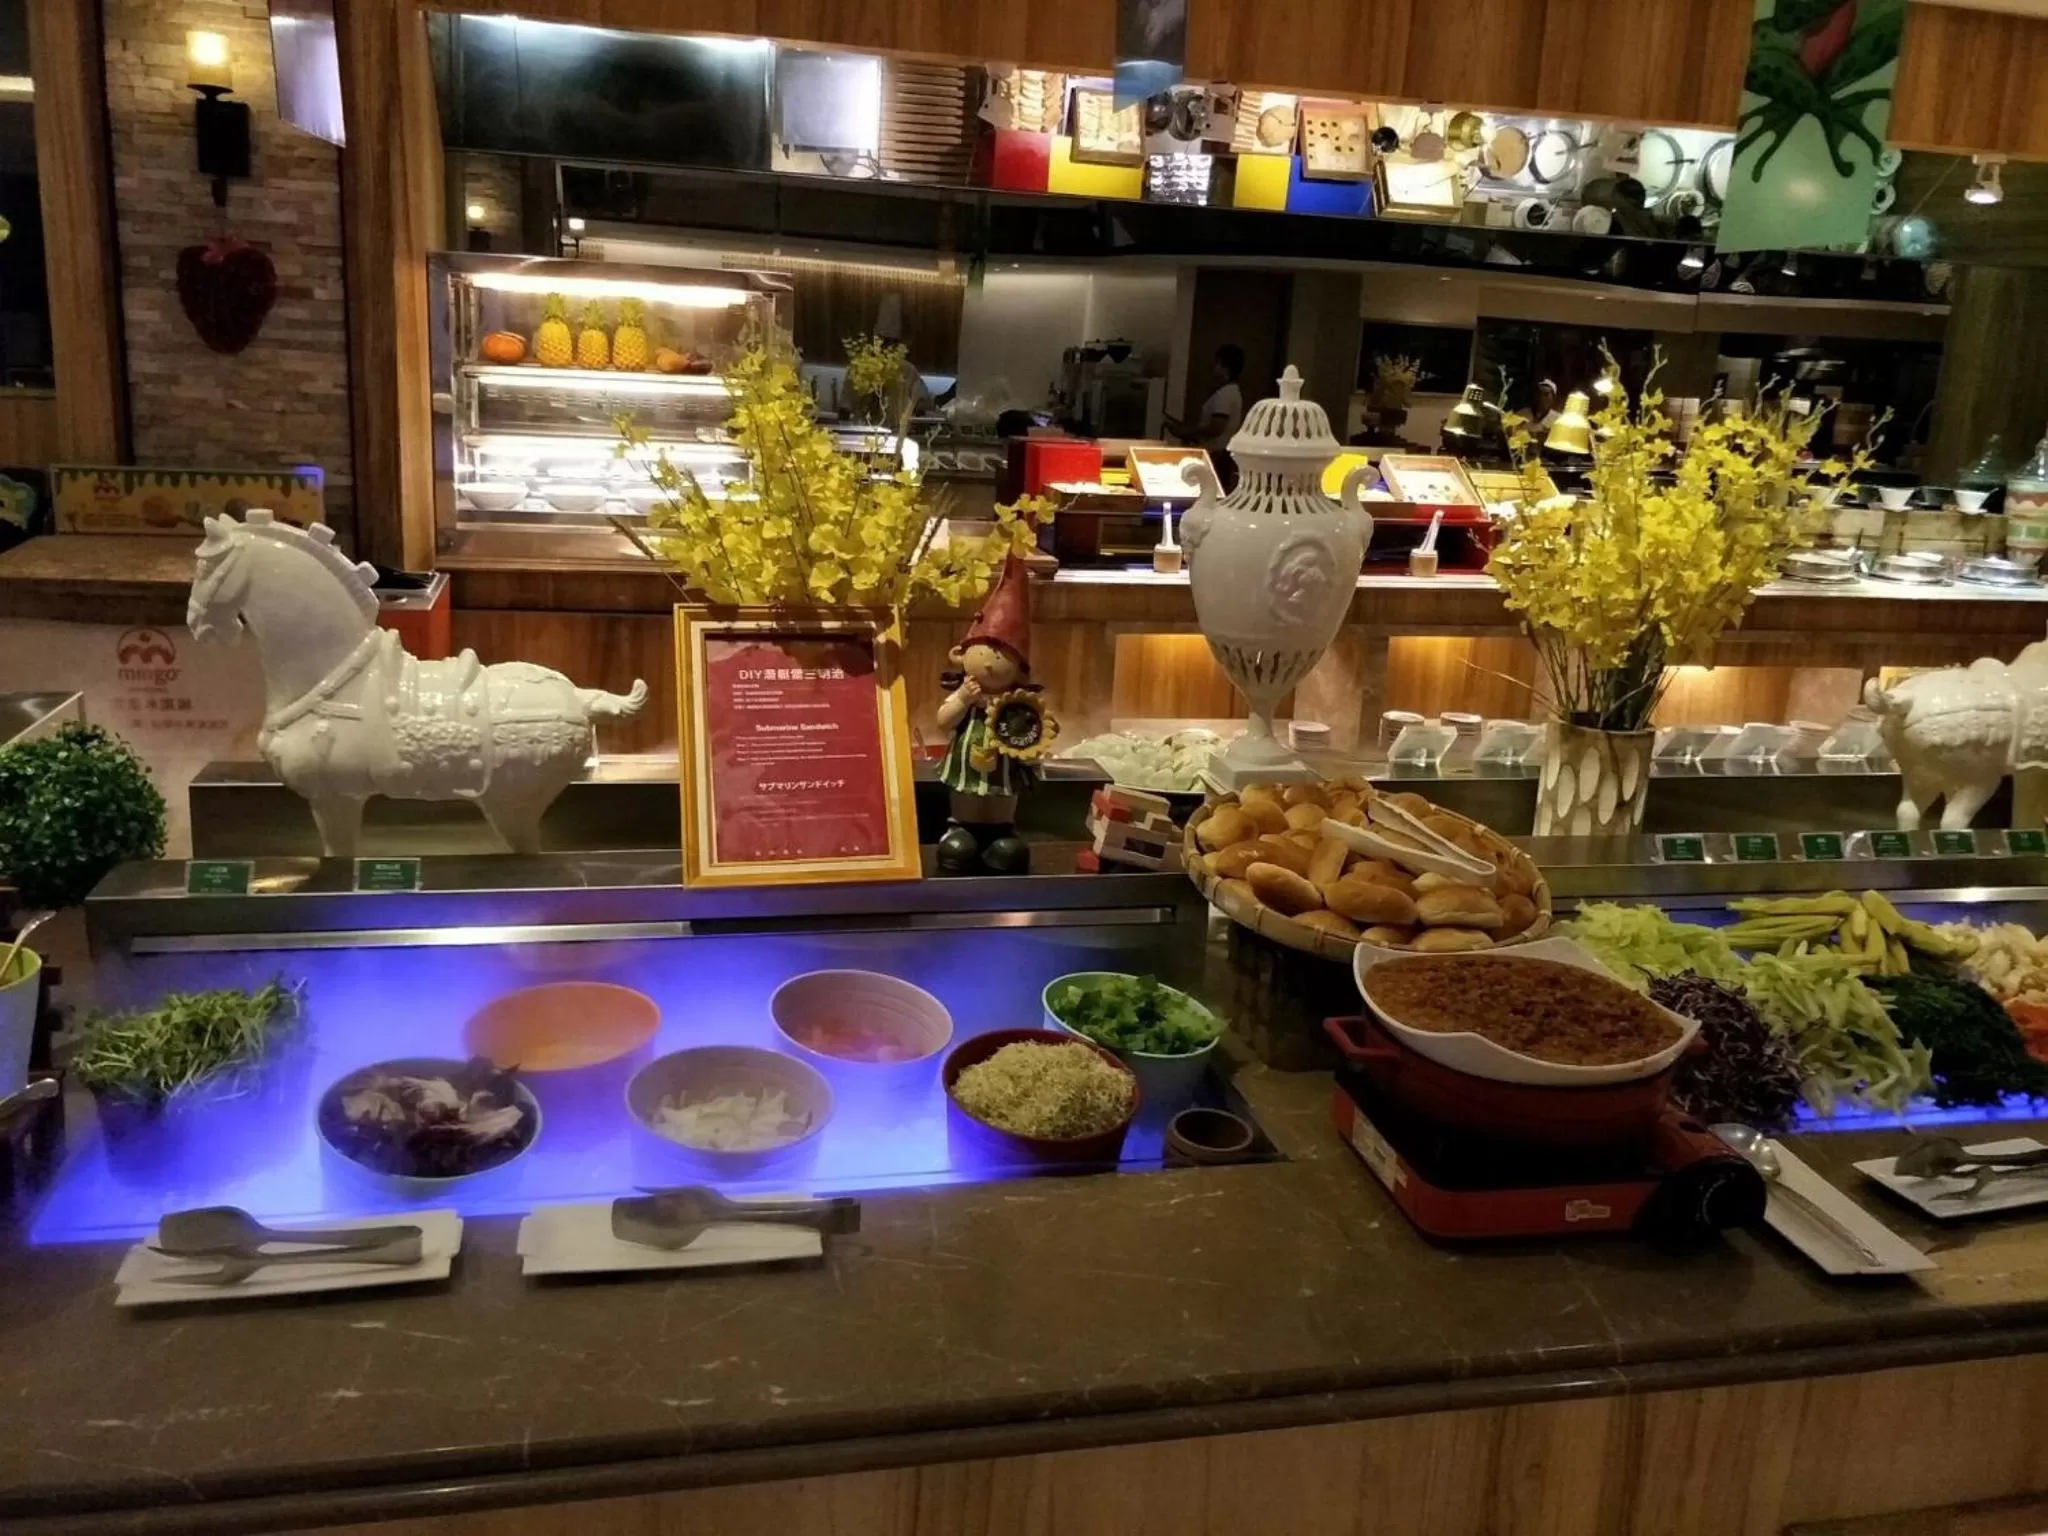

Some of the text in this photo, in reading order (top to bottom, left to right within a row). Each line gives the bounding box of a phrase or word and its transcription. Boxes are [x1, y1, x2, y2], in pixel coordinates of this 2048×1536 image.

[758, 779, 845, 791] サブマリンサンドイッチ
